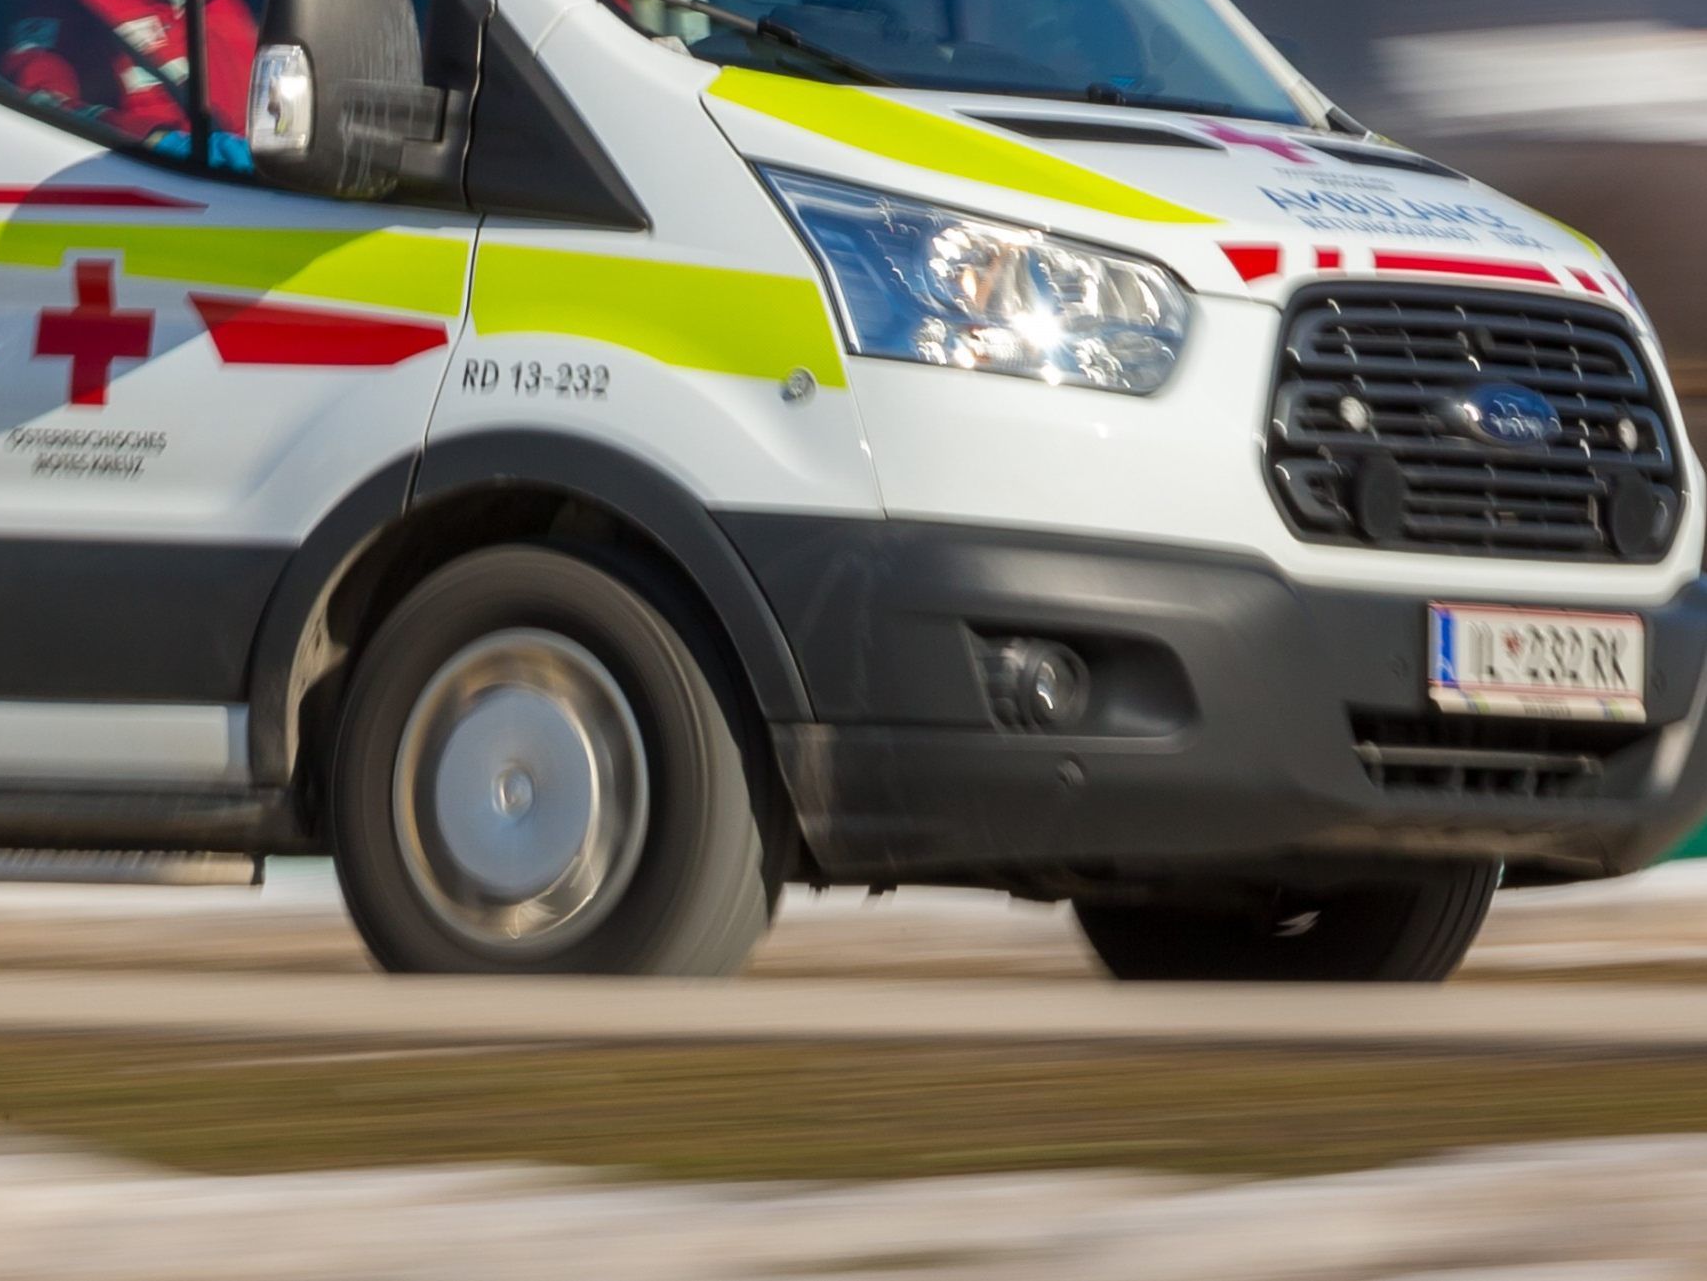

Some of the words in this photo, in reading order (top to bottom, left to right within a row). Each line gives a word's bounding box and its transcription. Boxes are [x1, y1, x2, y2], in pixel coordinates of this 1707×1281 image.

[1257, 185, 1522, 232] AMBULANCE
[462, 358, 500, 392] RD
[510, 361, 610, 398] 13-232
